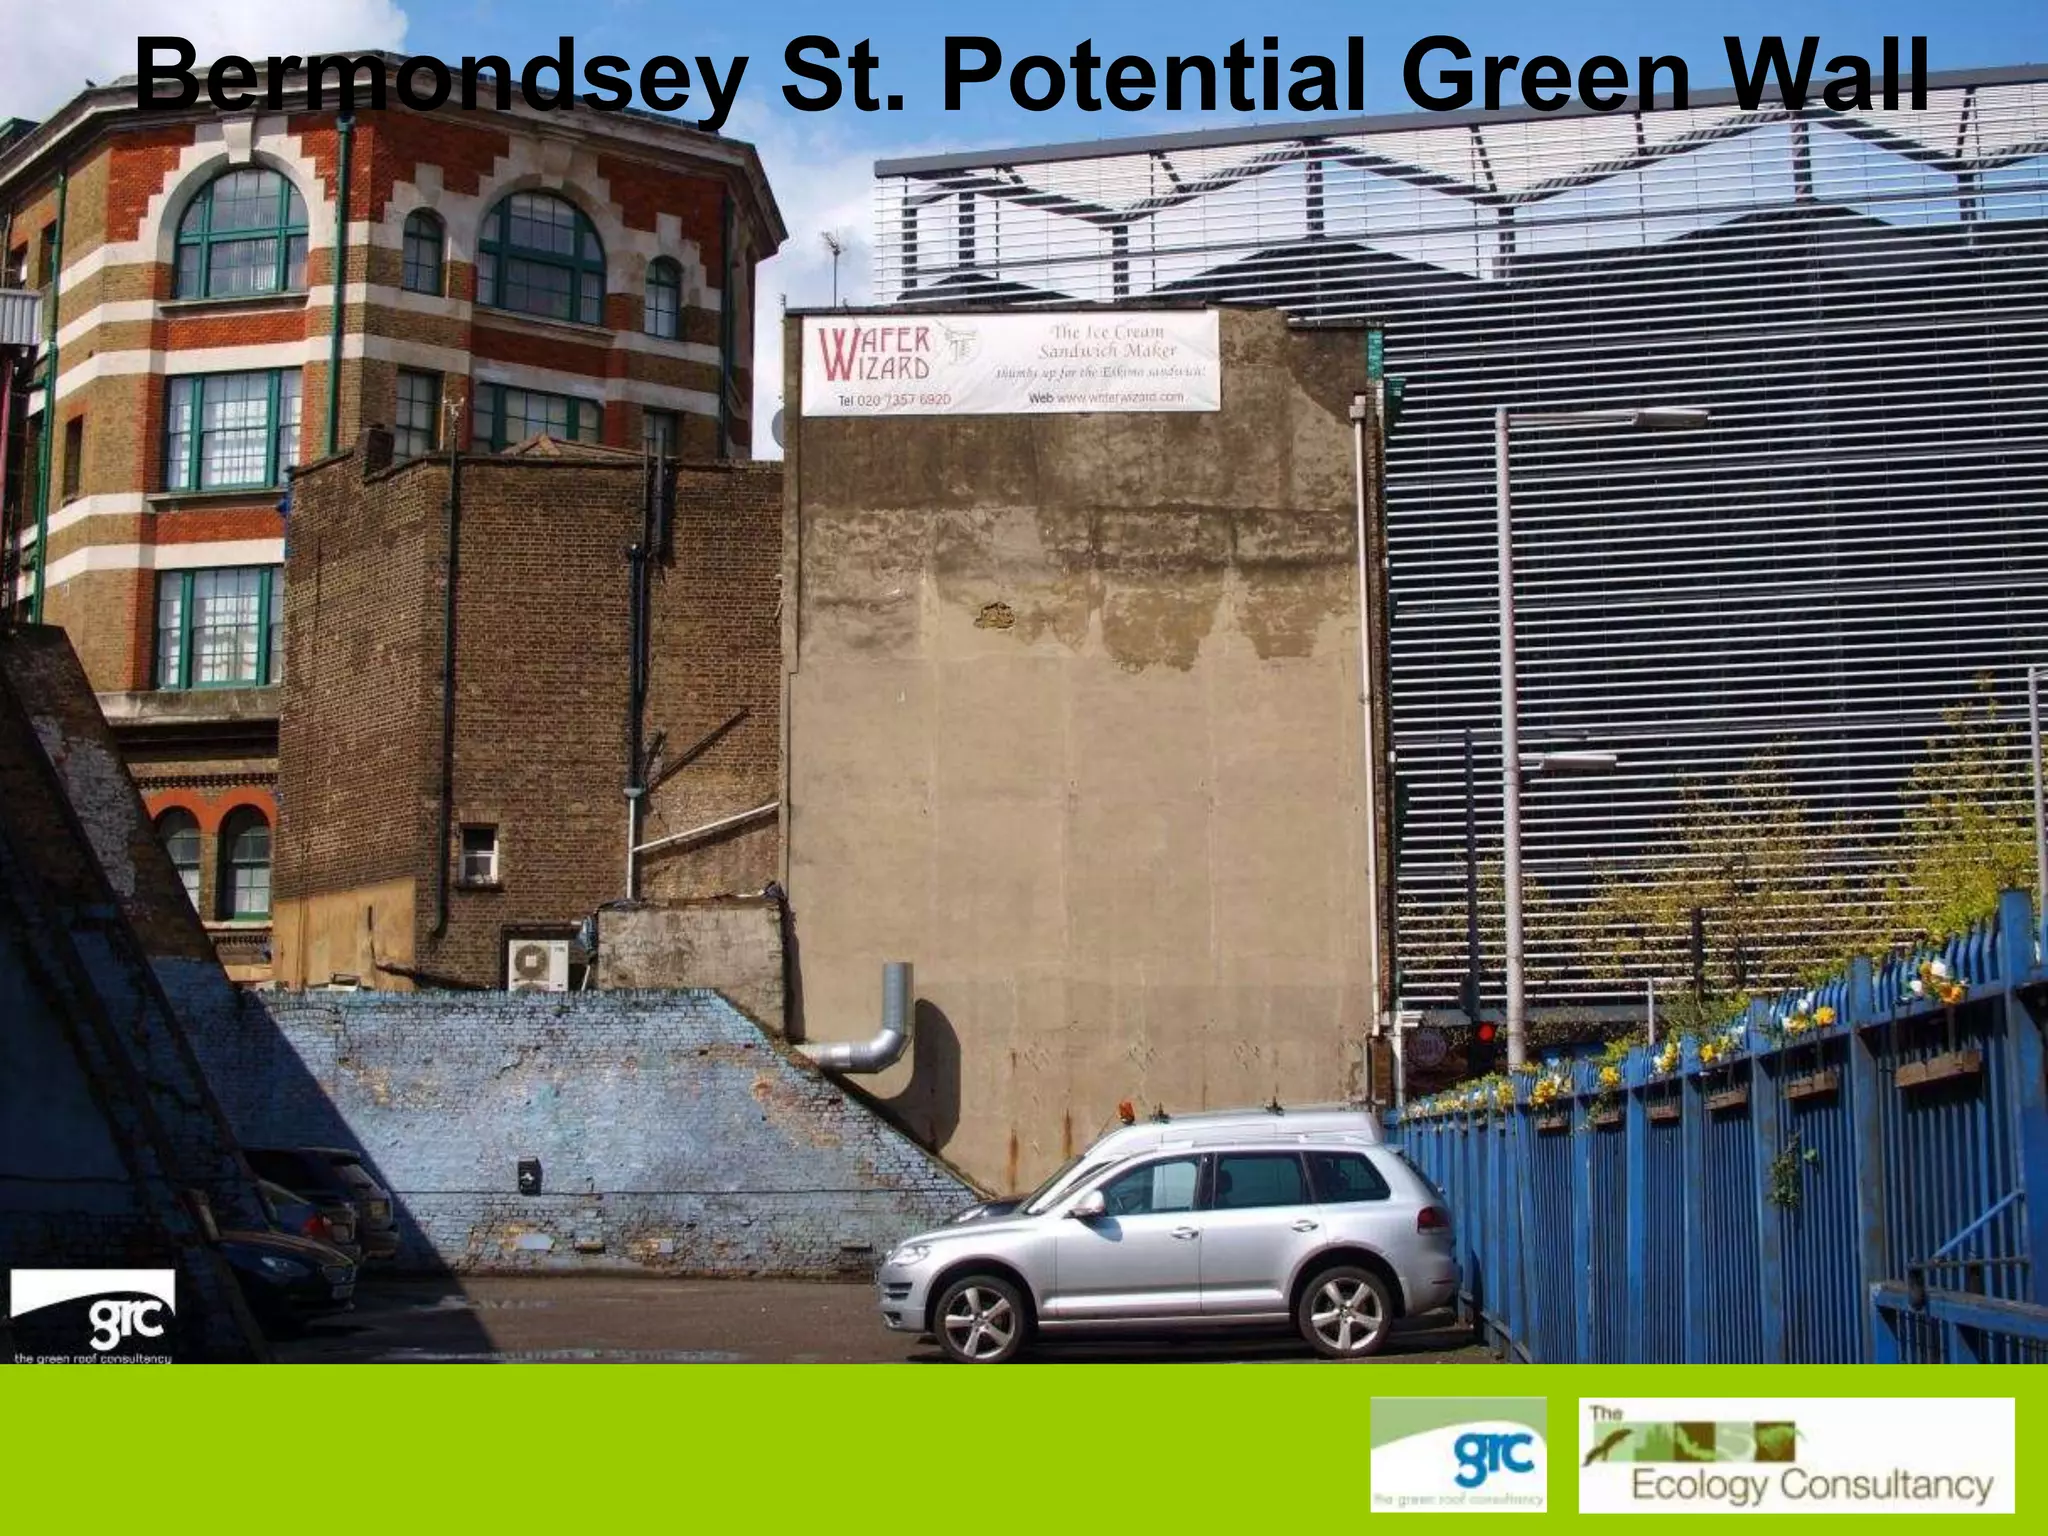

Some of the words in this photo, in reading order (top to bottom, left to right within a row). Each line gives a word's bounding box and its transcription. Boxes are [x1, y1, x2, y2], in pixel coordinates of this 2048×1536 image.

[1053, 324, 1080, 340] The
[1087, 324, 1109, 339] Ice
[1114, 324, 1165, 339] Cream
[1038, 342, 1117, 359] Sandwich
[1123, 342, 1177, 359] Maker
[838, 395, 854, 406] Tel
[857, 395, 881, 406] 020
[885, 394, 916, 406] 7357
[919, 394, 951, 405] 6920
[1028, 392, 1054, 404] Web
